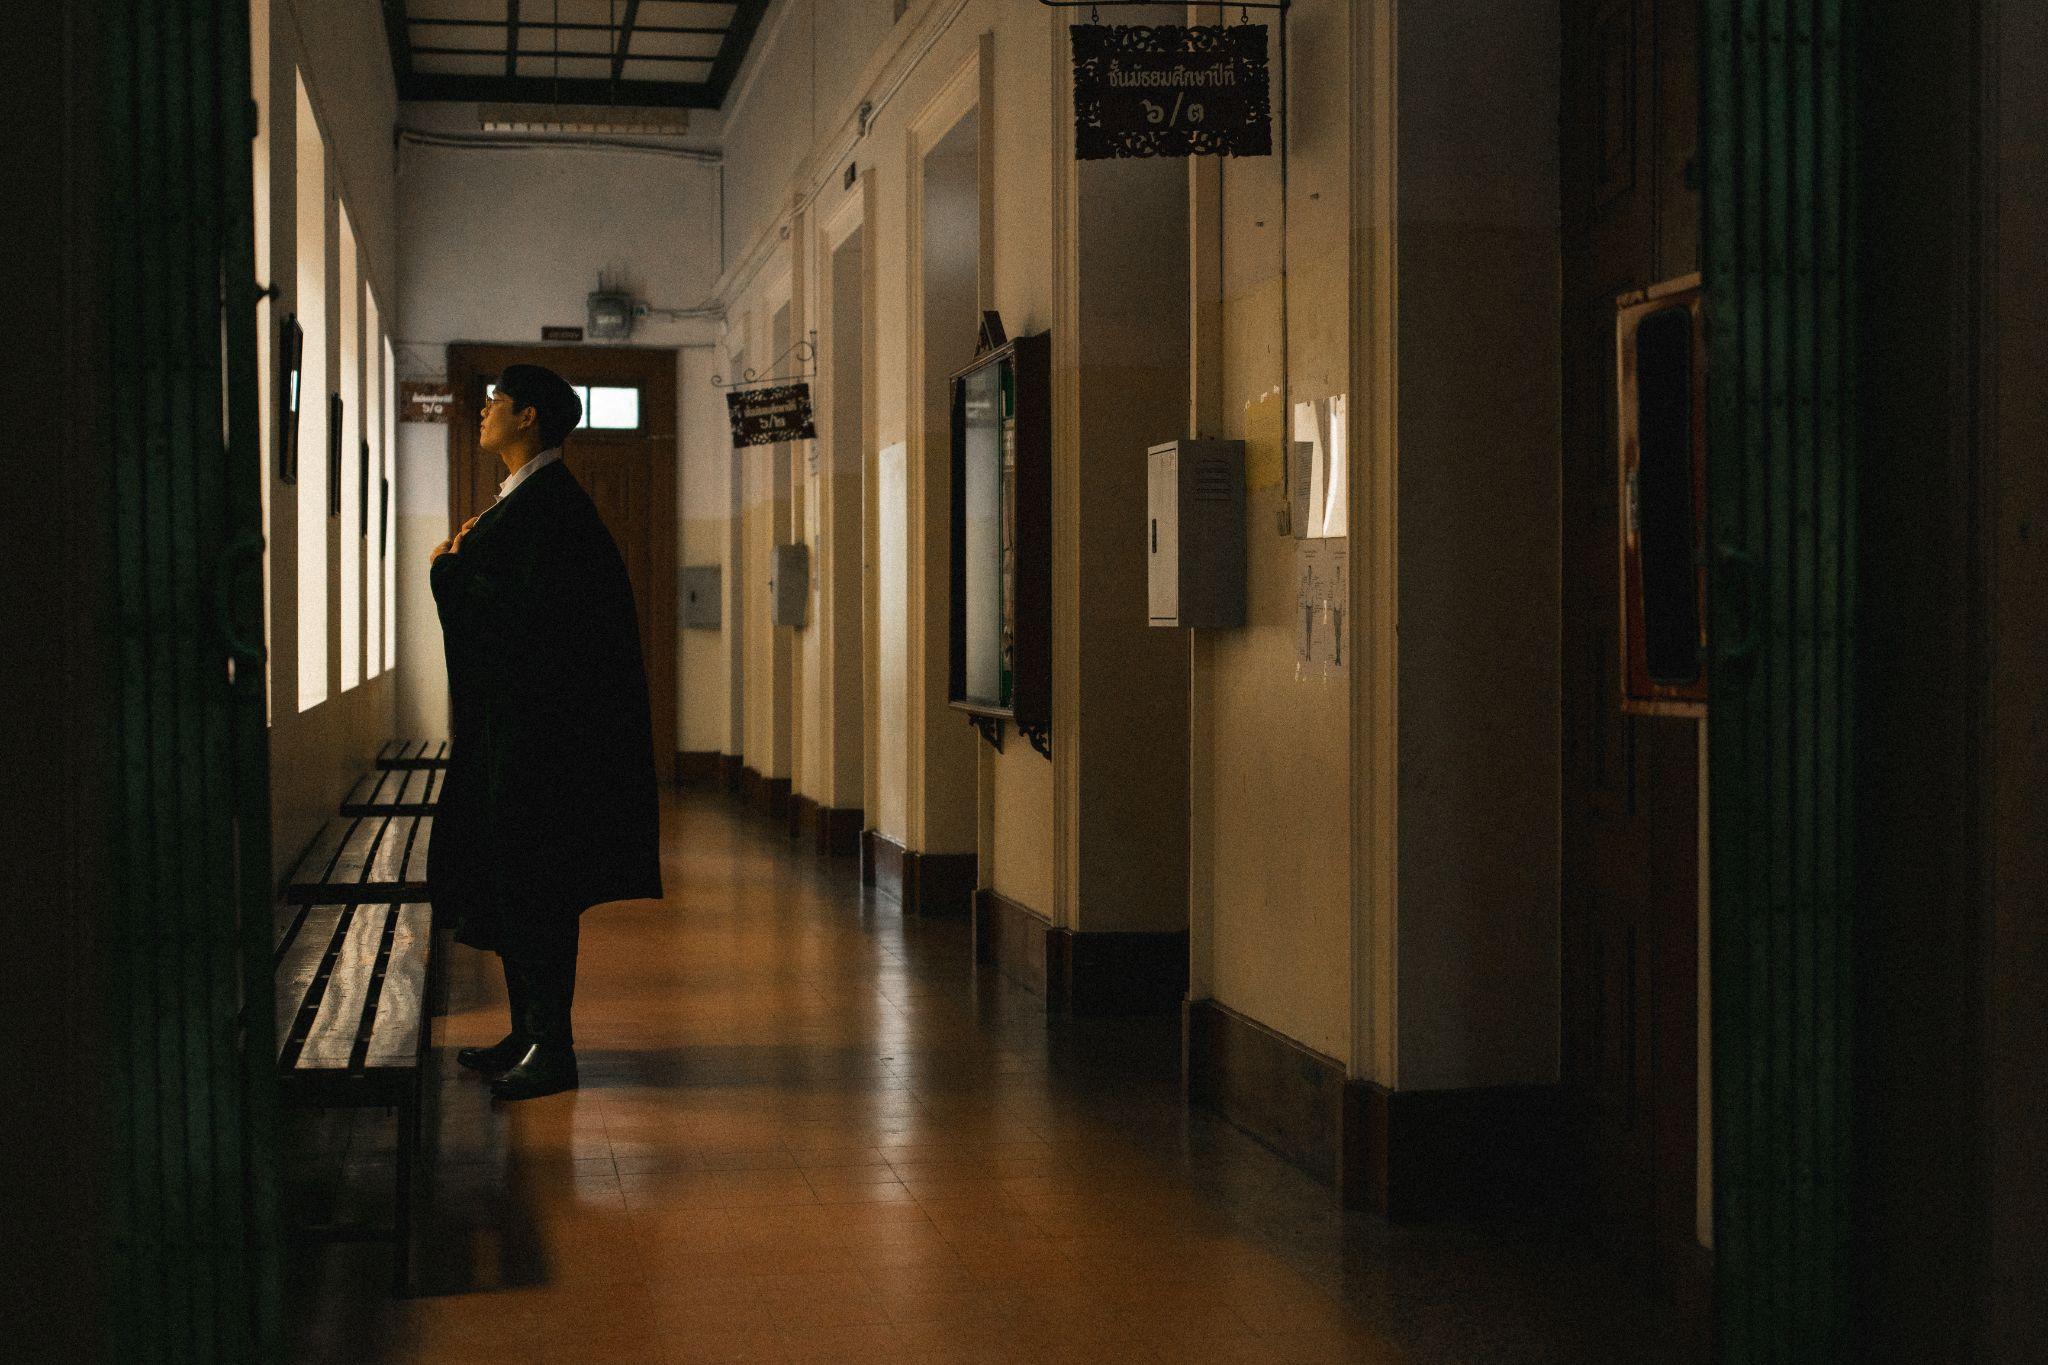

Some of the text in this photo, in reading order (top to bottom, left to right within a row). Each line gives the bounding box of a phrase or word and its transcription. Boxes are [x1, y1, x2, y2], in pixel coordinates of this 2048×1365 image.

[1107, 57, 1236, 87] ชั้นมัธยมศึกษาปีที่
